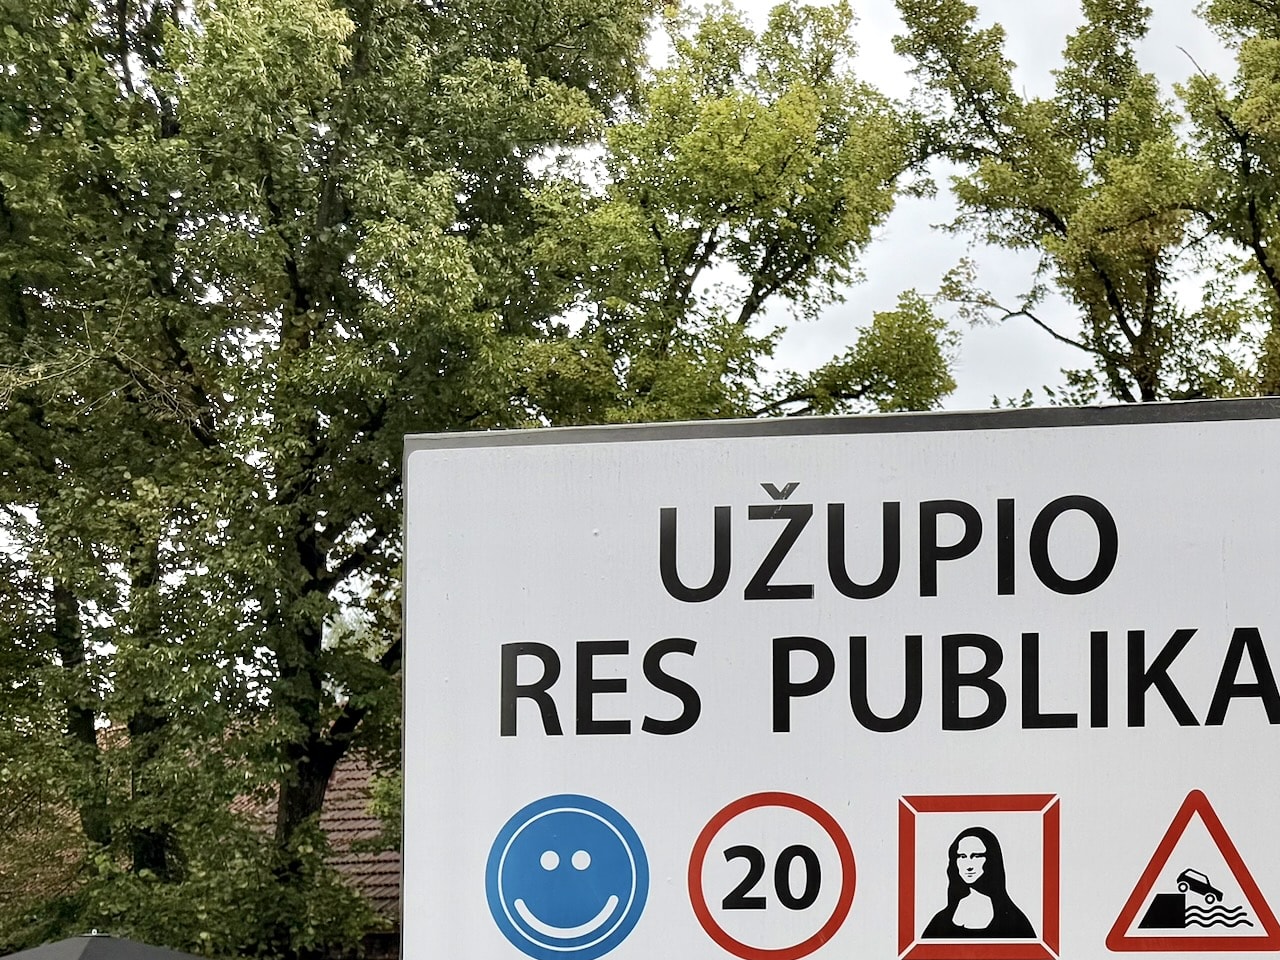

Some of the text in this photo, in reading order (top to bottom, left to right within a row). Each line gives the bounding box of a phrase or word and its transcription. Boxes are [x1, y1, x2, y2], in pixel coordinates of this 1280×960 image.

[659, 482, 1119, 603] UŽUPIO
[500, 637, 702, 737] RES
[721, 844, 822, 911] 20
